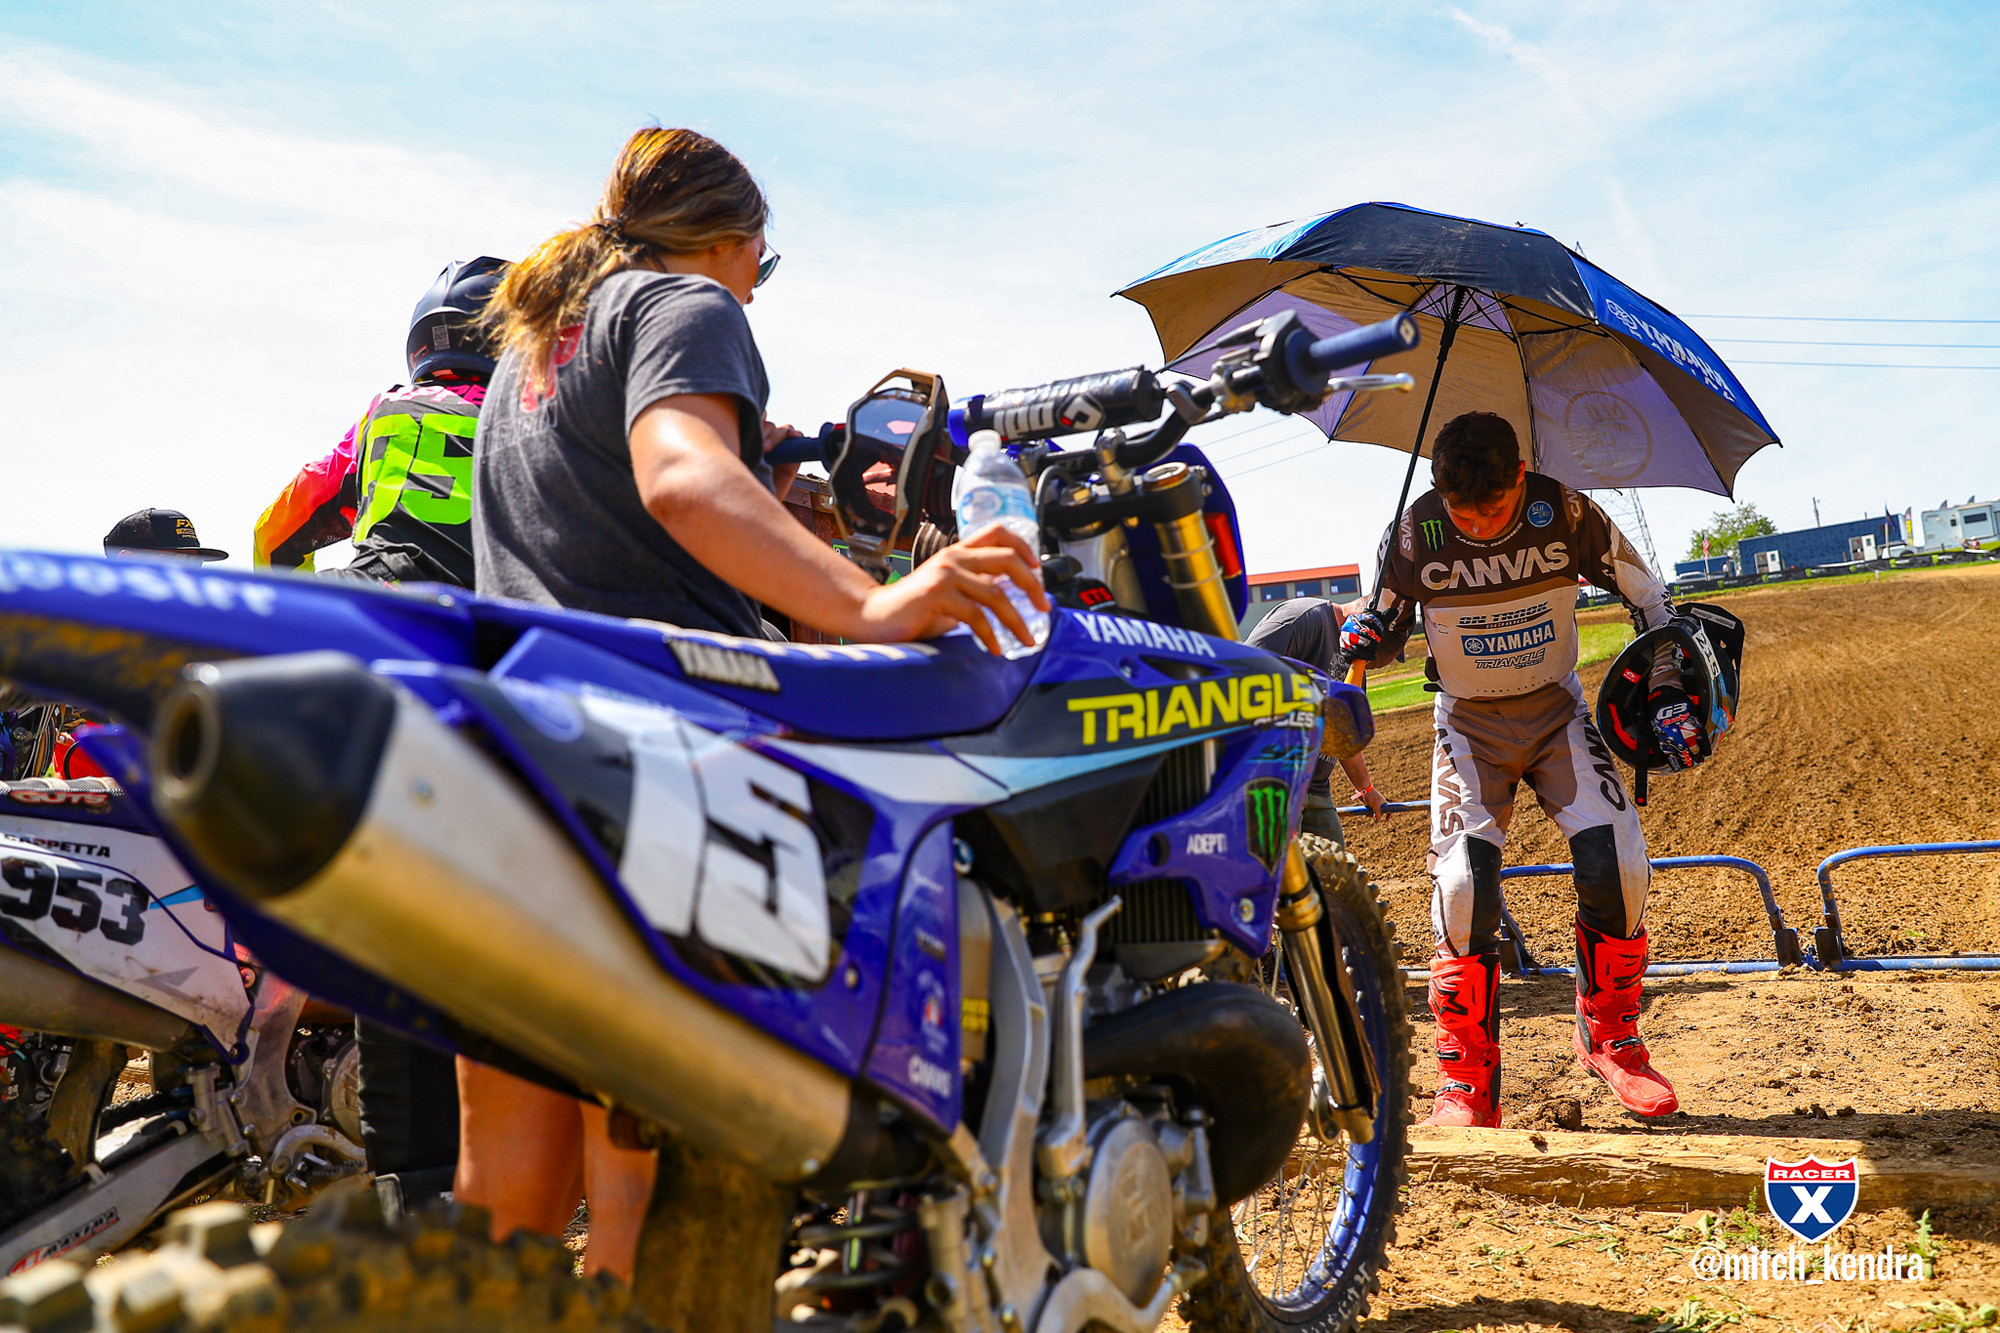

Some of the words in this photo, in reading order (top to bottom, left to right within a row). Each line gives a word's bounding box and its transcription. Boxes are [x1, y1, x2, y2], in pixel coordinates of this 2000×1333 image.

[1420, 541, 1570, 591] CANVAS
[1072, 612, 1216, 658] YAMAHA
[1459, 616, 1487, 625] ON
[1491, 601, 1549, 622] TRACK
[1474, 648, 1546, 669] TRIANGLE
[1484, 624, 1553, 653] YAMAHA
[1696, 632, 1720, 677] 215
[1067, 672, 1316, 746] TRIANGLE
[1656, 702, 1688, 720] G3
[11, 791, 108, 805] GUTS
[1437, 728, 1464, 838] ANVAS
[0, 856, 150, 946] 953
